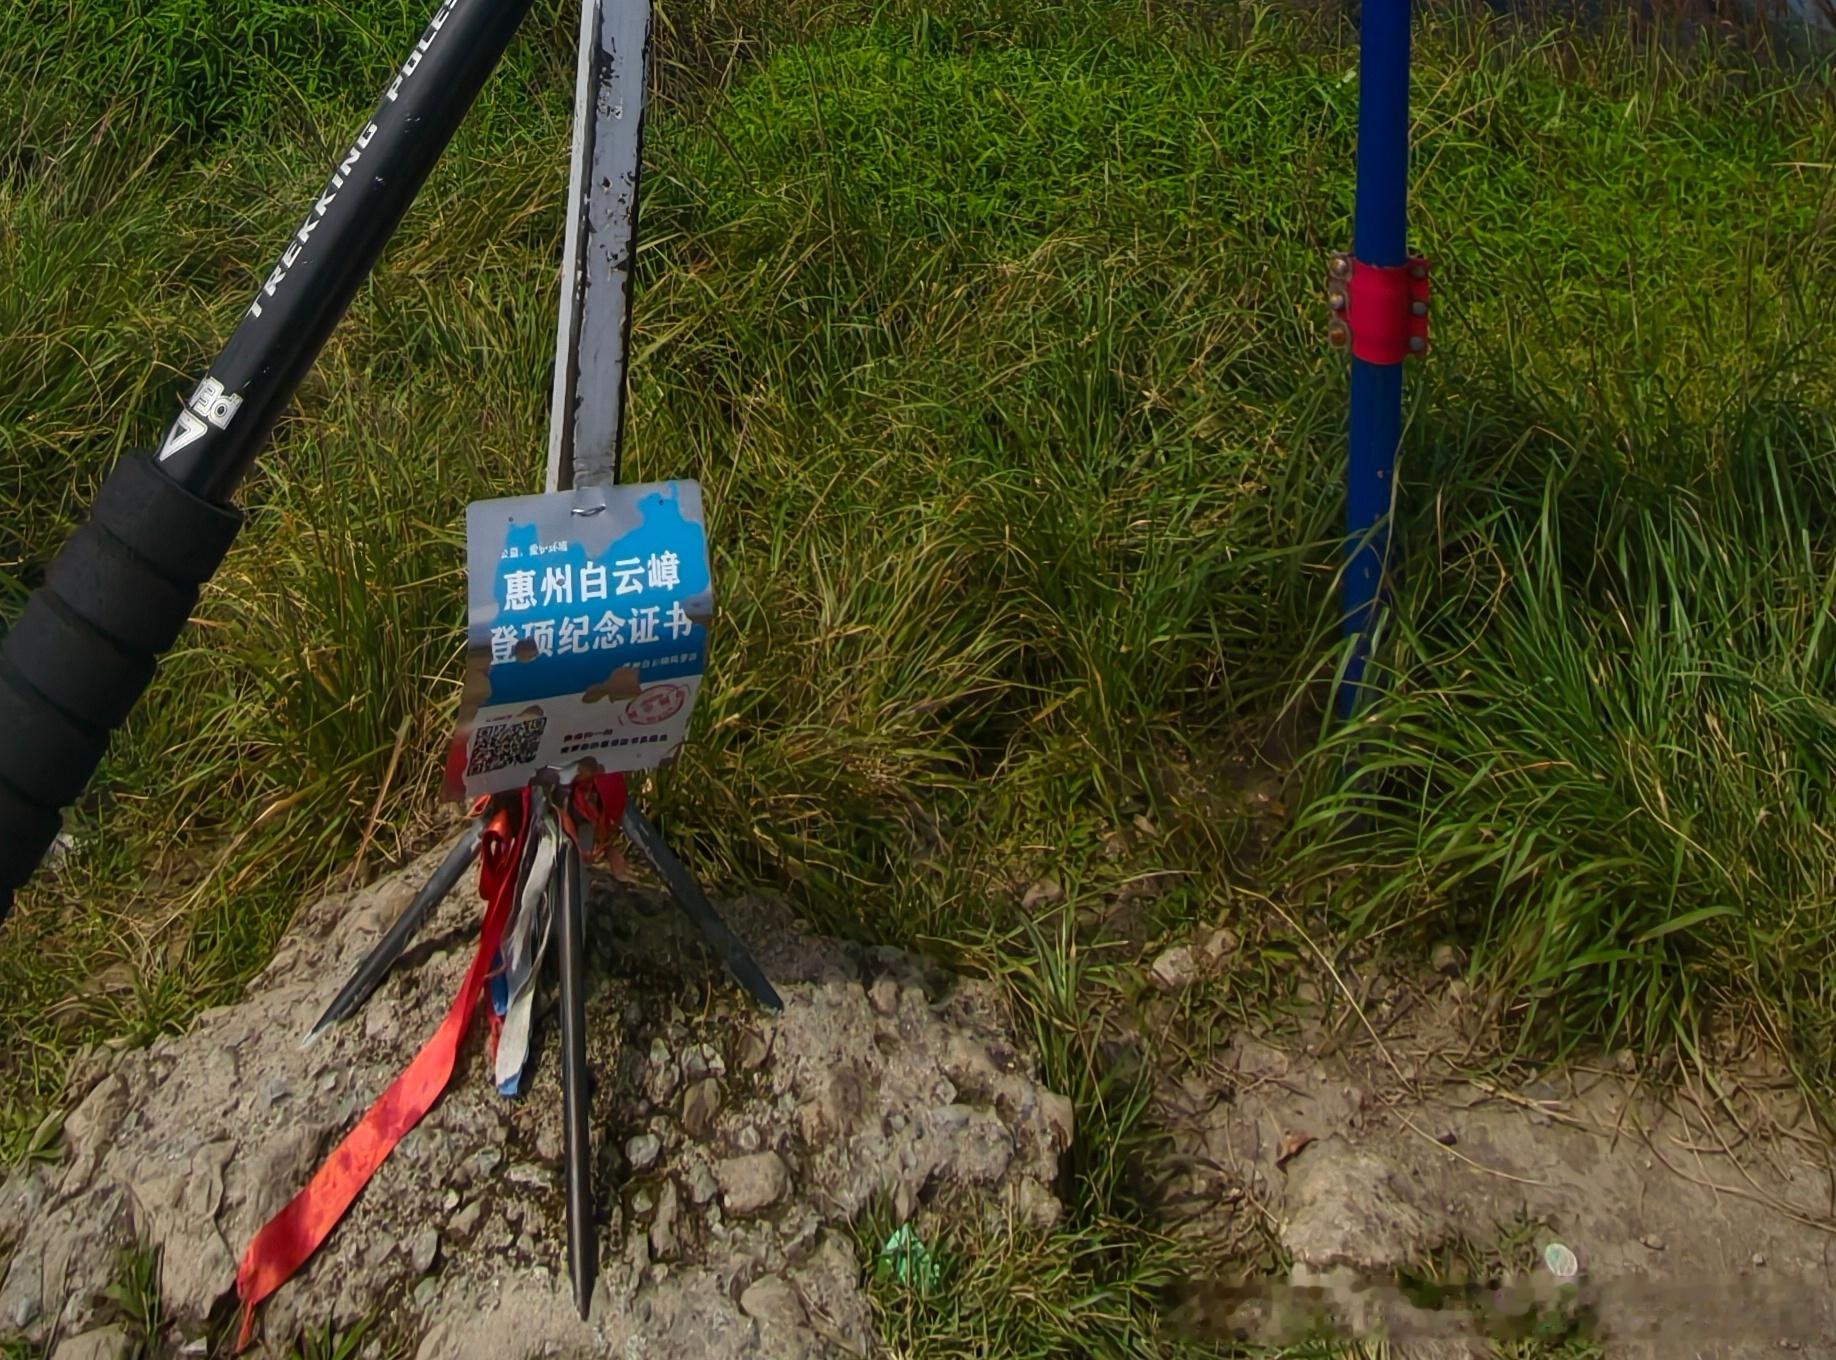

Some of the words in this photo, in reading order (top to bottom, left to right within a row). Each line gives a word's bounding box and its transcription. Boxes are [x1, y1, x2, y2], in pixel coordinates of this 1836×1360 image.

[246, 120, 378, 319] TREKKING
[503, 550, 680, 611] 惠州白云嶂
[490, 601, 693, 666] 登顶纪念证书
